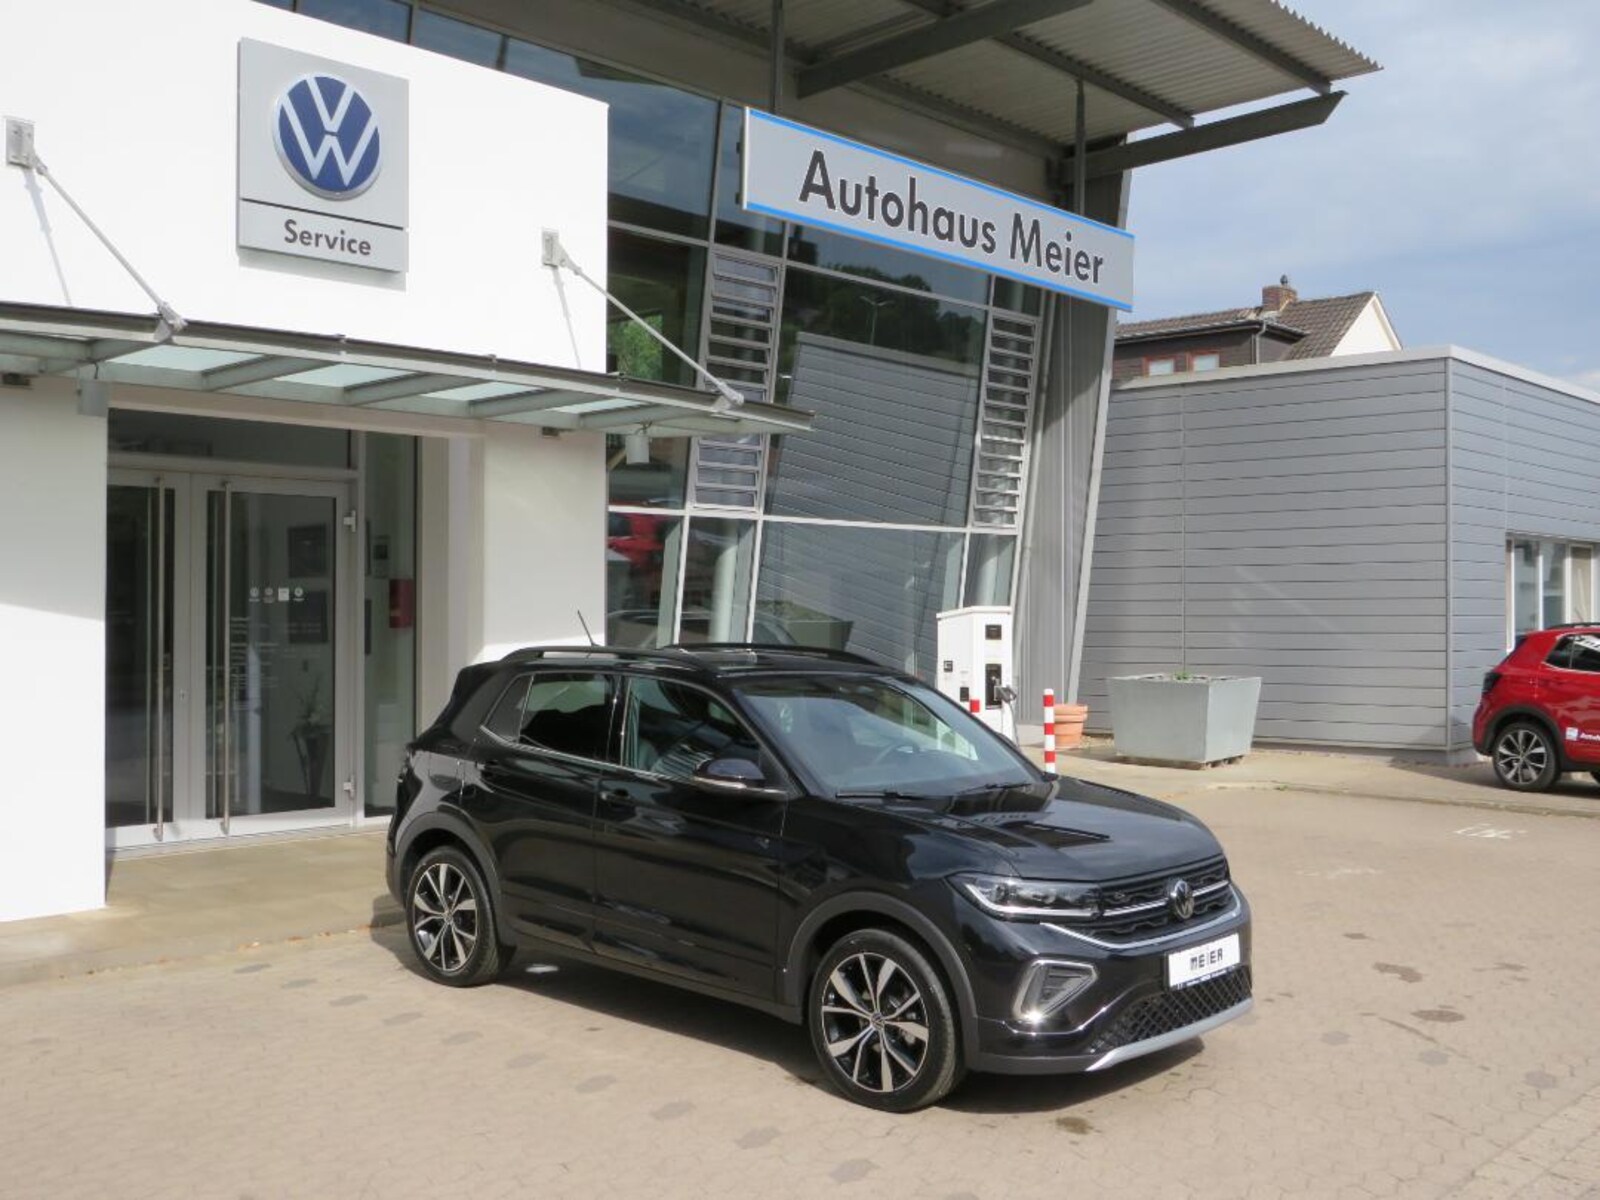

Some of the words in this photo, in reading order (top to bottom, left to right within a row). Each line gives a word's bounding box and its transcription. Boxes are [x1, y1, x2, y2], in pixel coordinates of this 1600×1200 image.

[277, 75, 380, 192] VW
[283, 218, 372, 256] Service
[798, 149, 997, 254] Autohaus
[1009, 212, 1104, 284] Meier
[1190, 947, 1223, 971] MEIER
